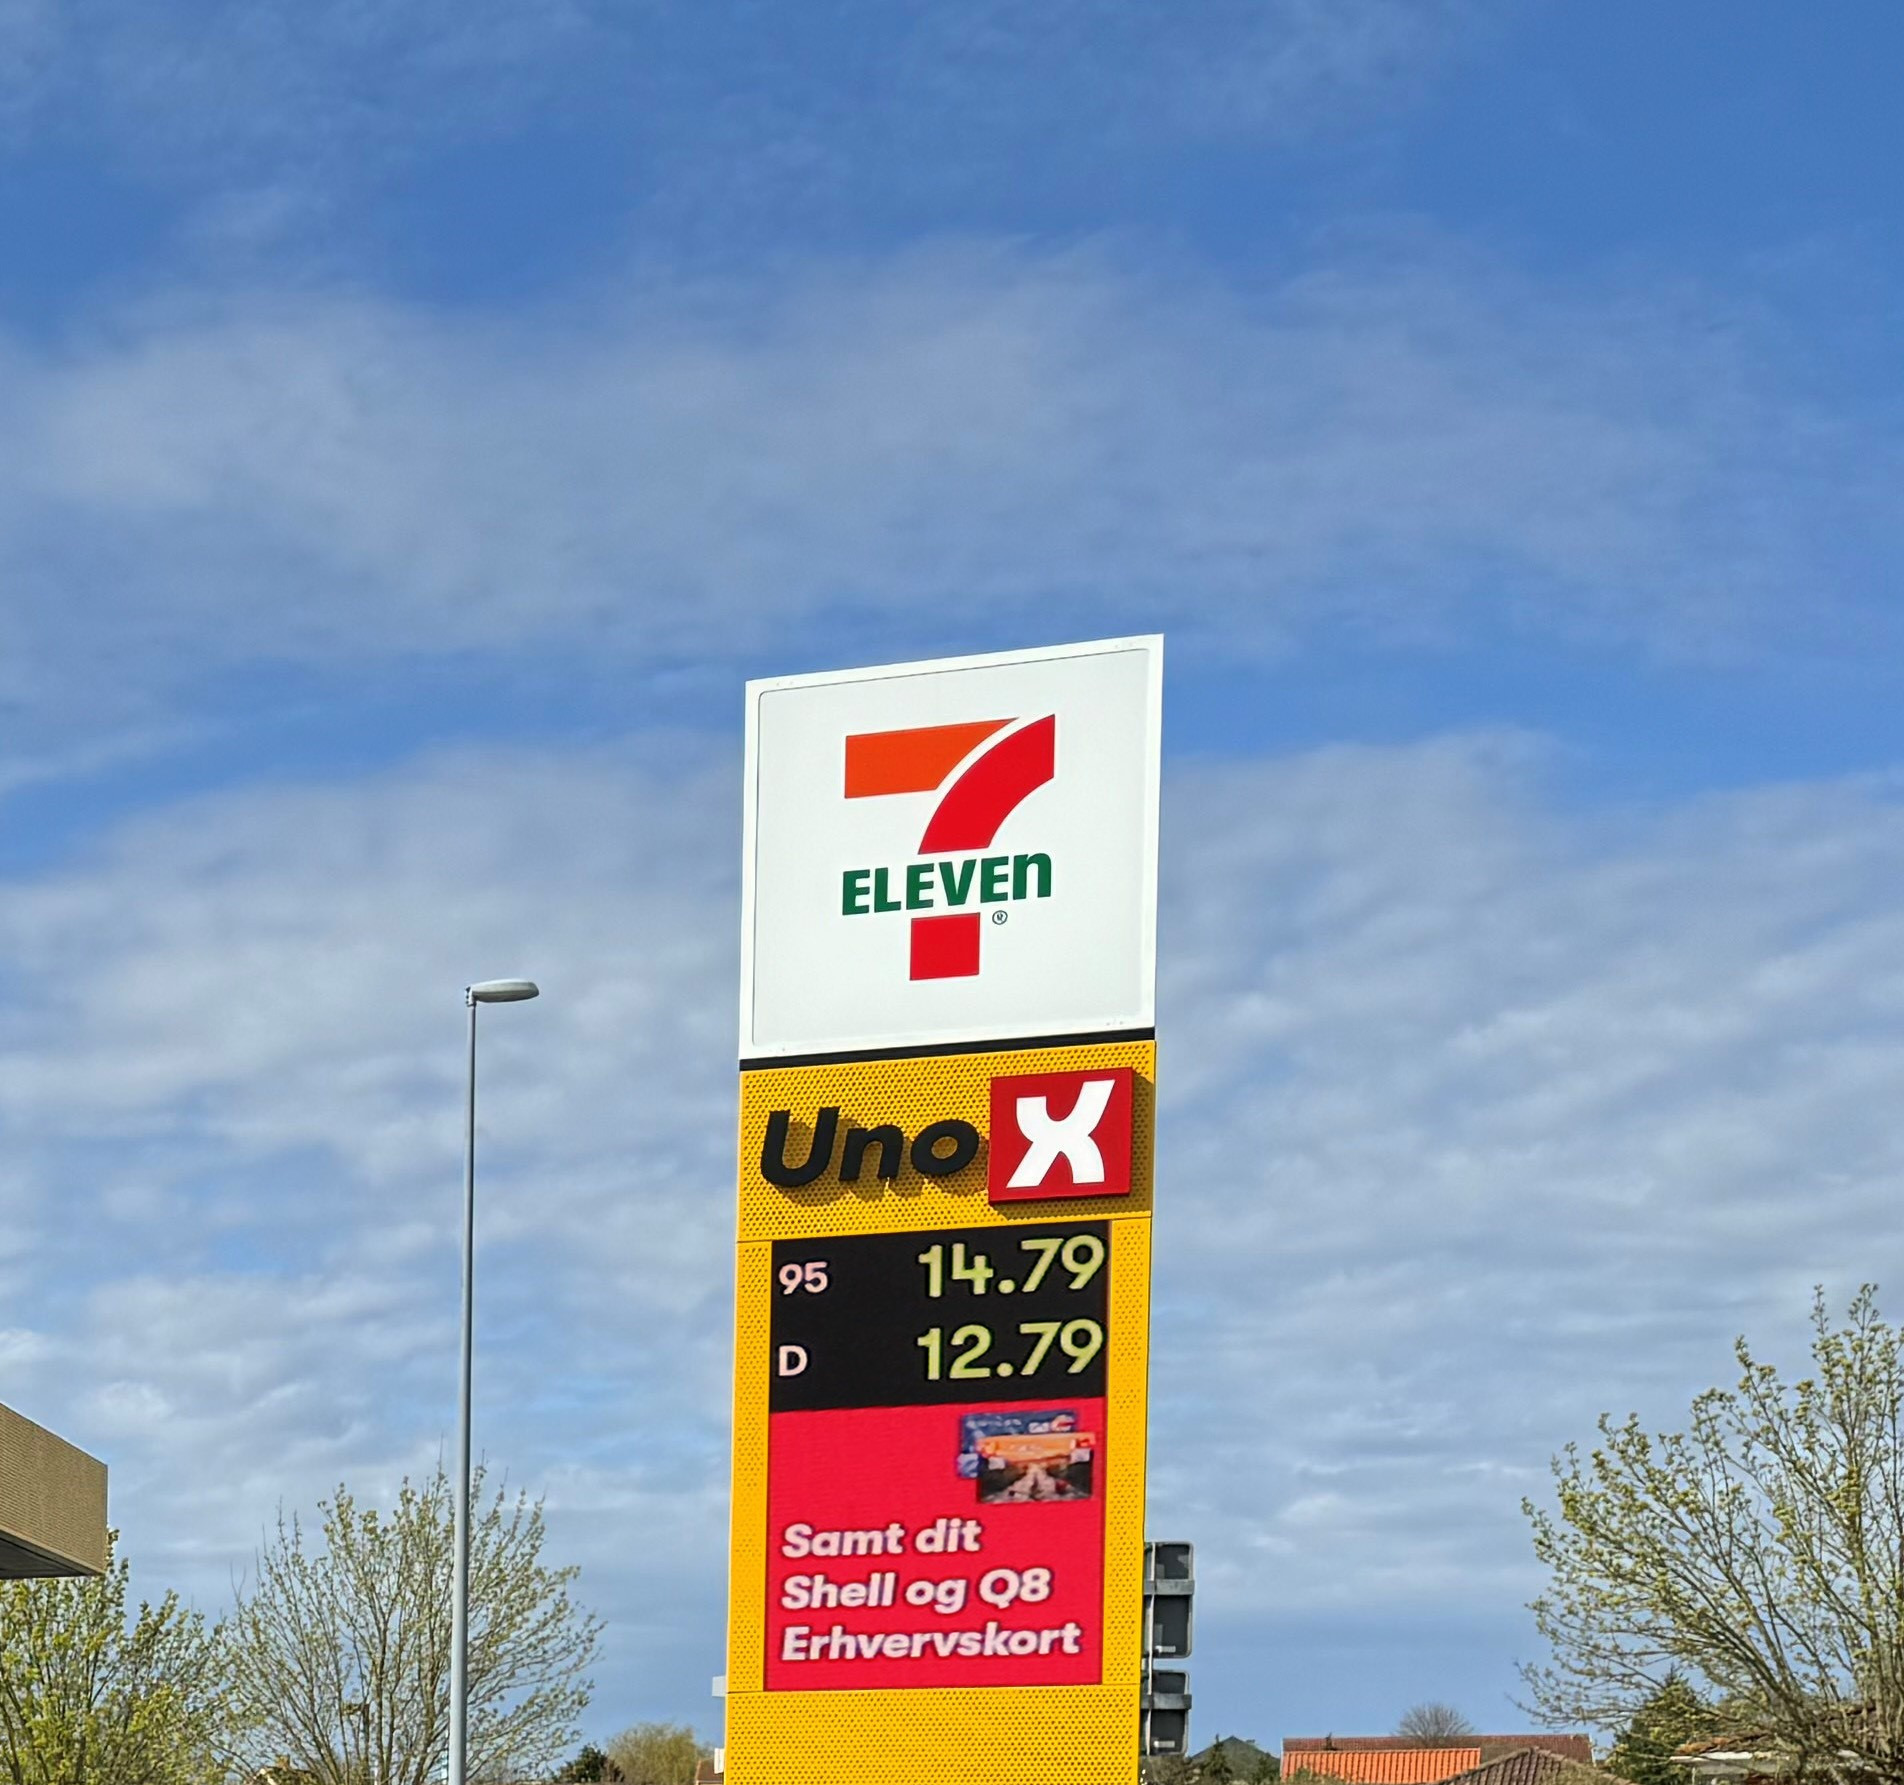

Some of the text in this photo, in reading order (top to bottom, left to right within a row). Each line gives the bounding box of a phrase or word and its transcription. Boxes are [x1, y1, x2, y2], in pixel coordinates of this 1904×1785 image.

[760, 1079, 1115, 1188] Uno X
[778, 1235, 1105, 1297] 95 14.79
[778, 1318, 1103, 1380] D 12.79
[782, 1518, 982, 1558] Samt dit
[781, 1567, 1051, 1614] Shell og Q8
[782, 1622, 1081, 1661] Erhvervskort
